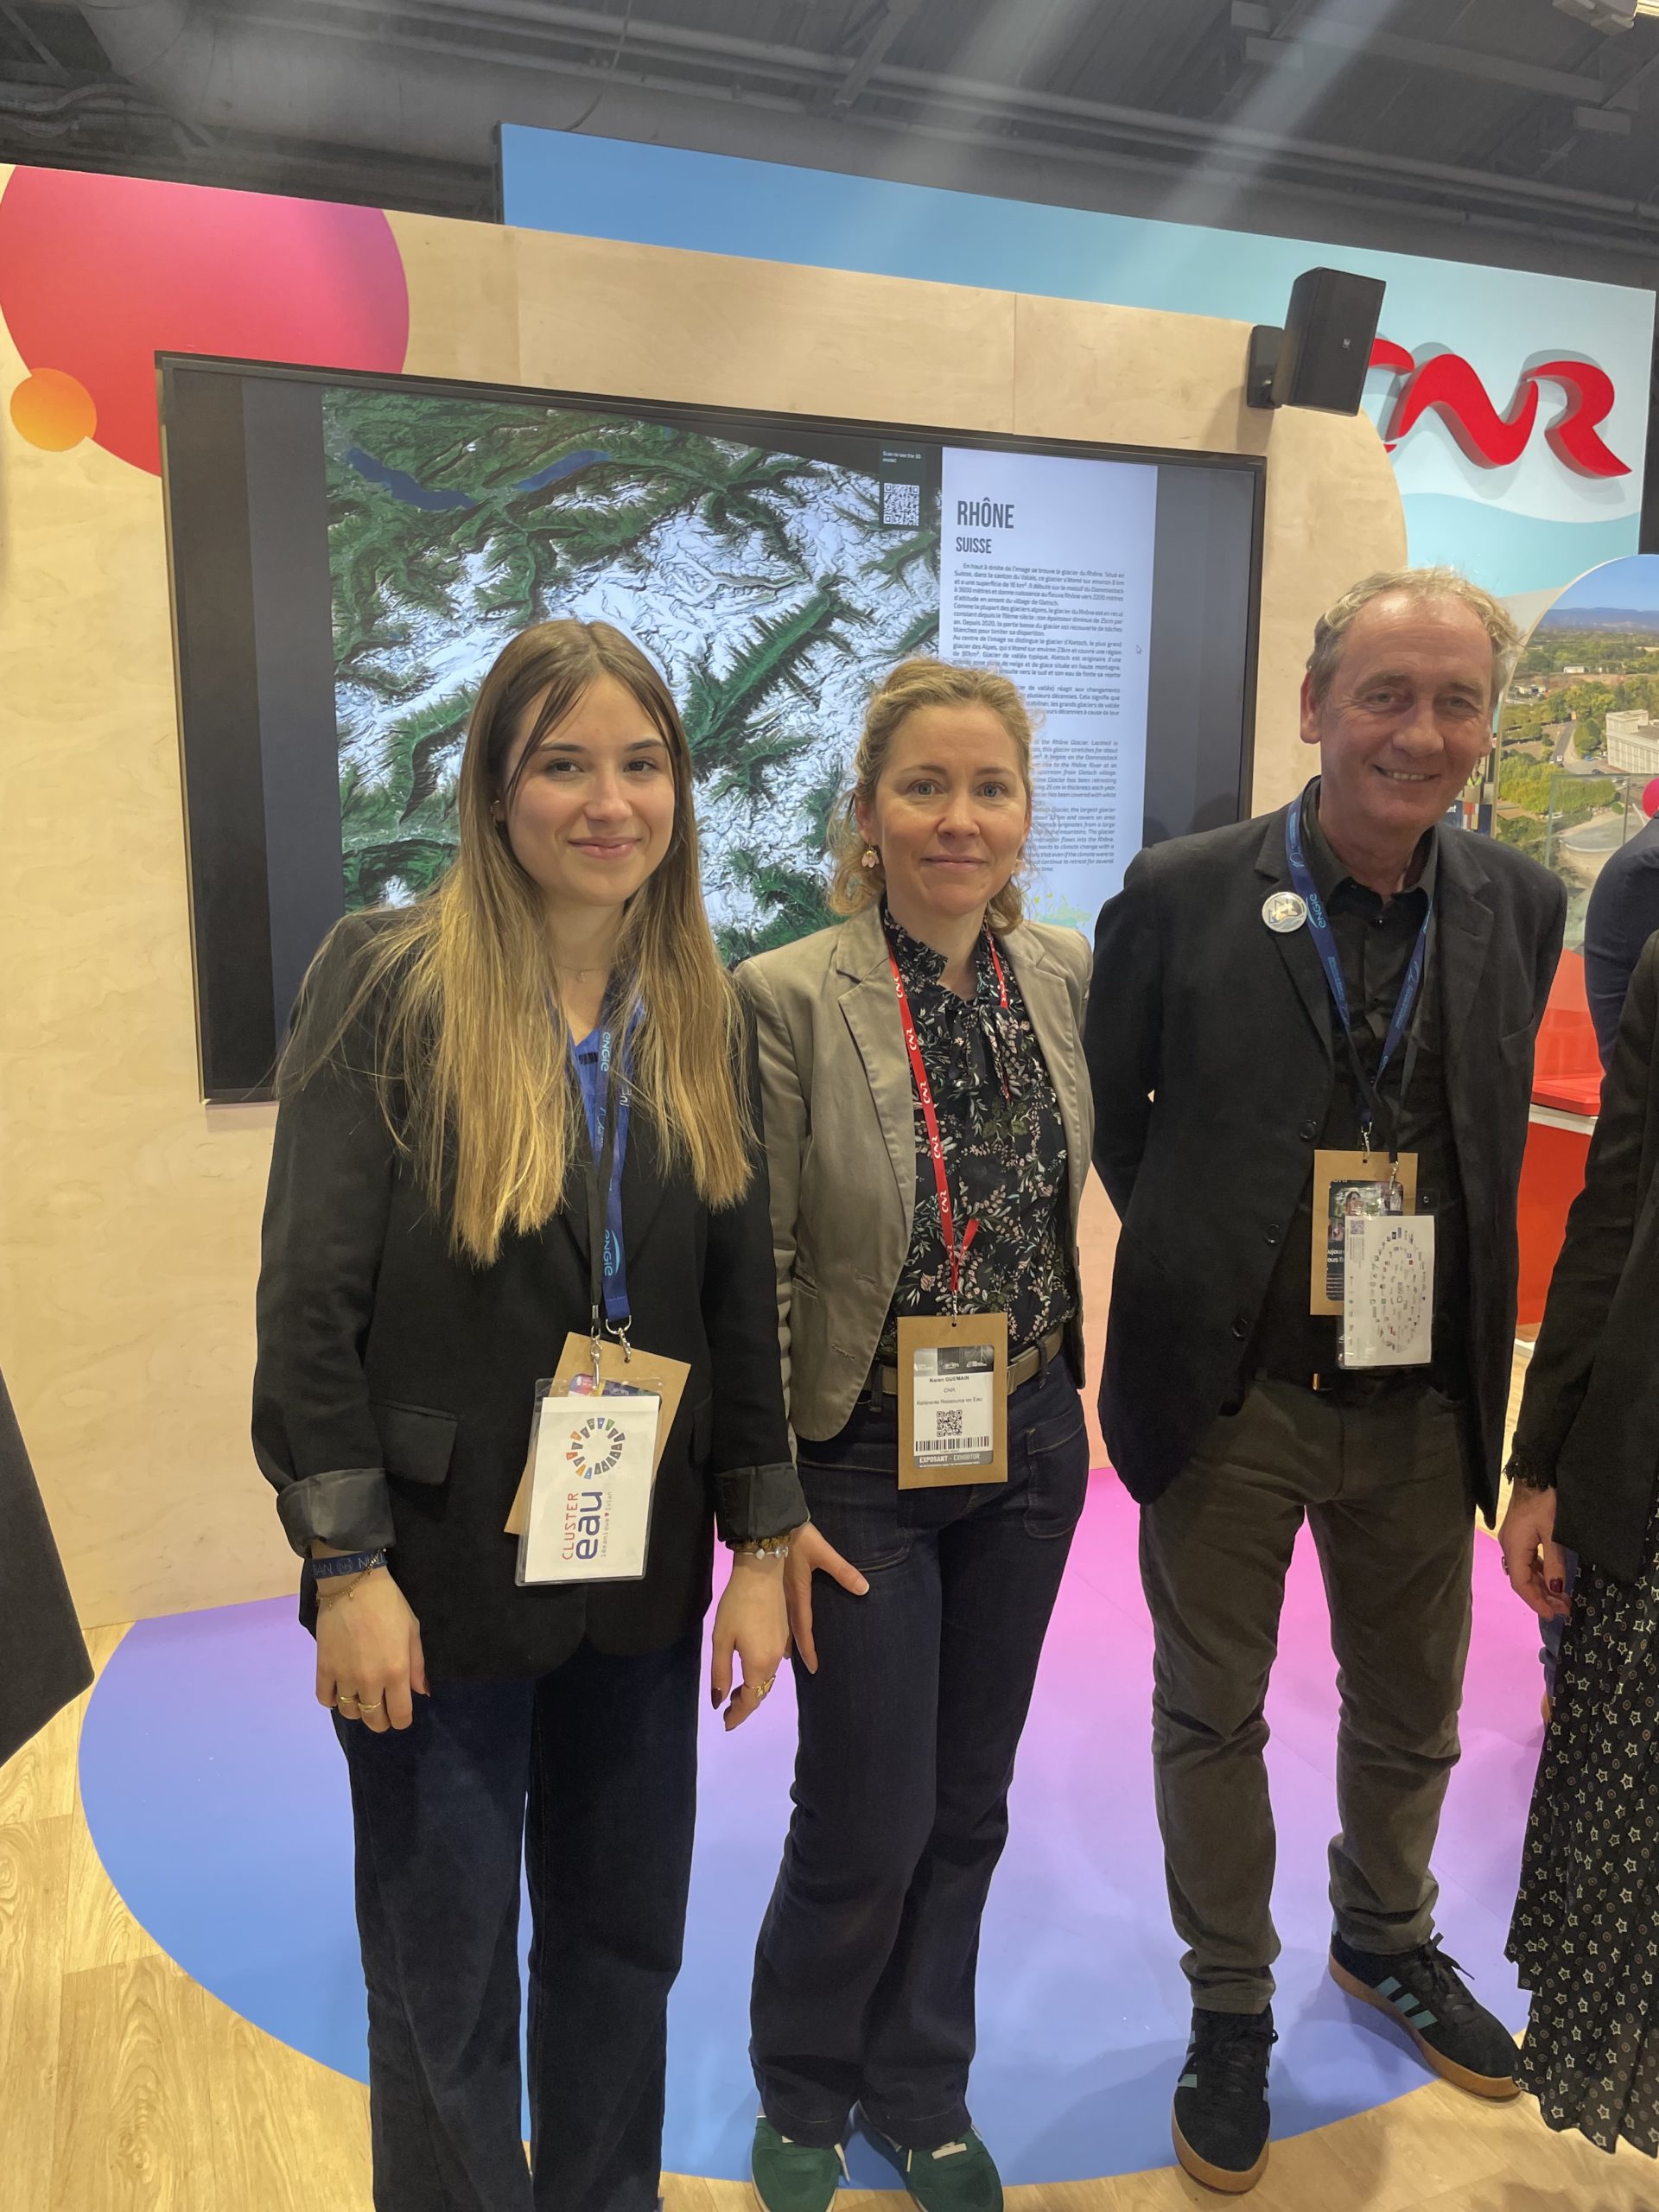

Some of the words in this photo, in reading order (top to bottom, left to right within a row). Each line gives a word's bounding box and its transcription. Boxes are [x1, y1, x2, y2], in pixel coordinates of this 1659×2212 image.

[957, 498, 1014, 529] RHÔNE
[956, 537, 992, 554] SUISSE
[562, 1493, 578, 1560] CLUSTER
[576, 1491, 603, 1560] eau
